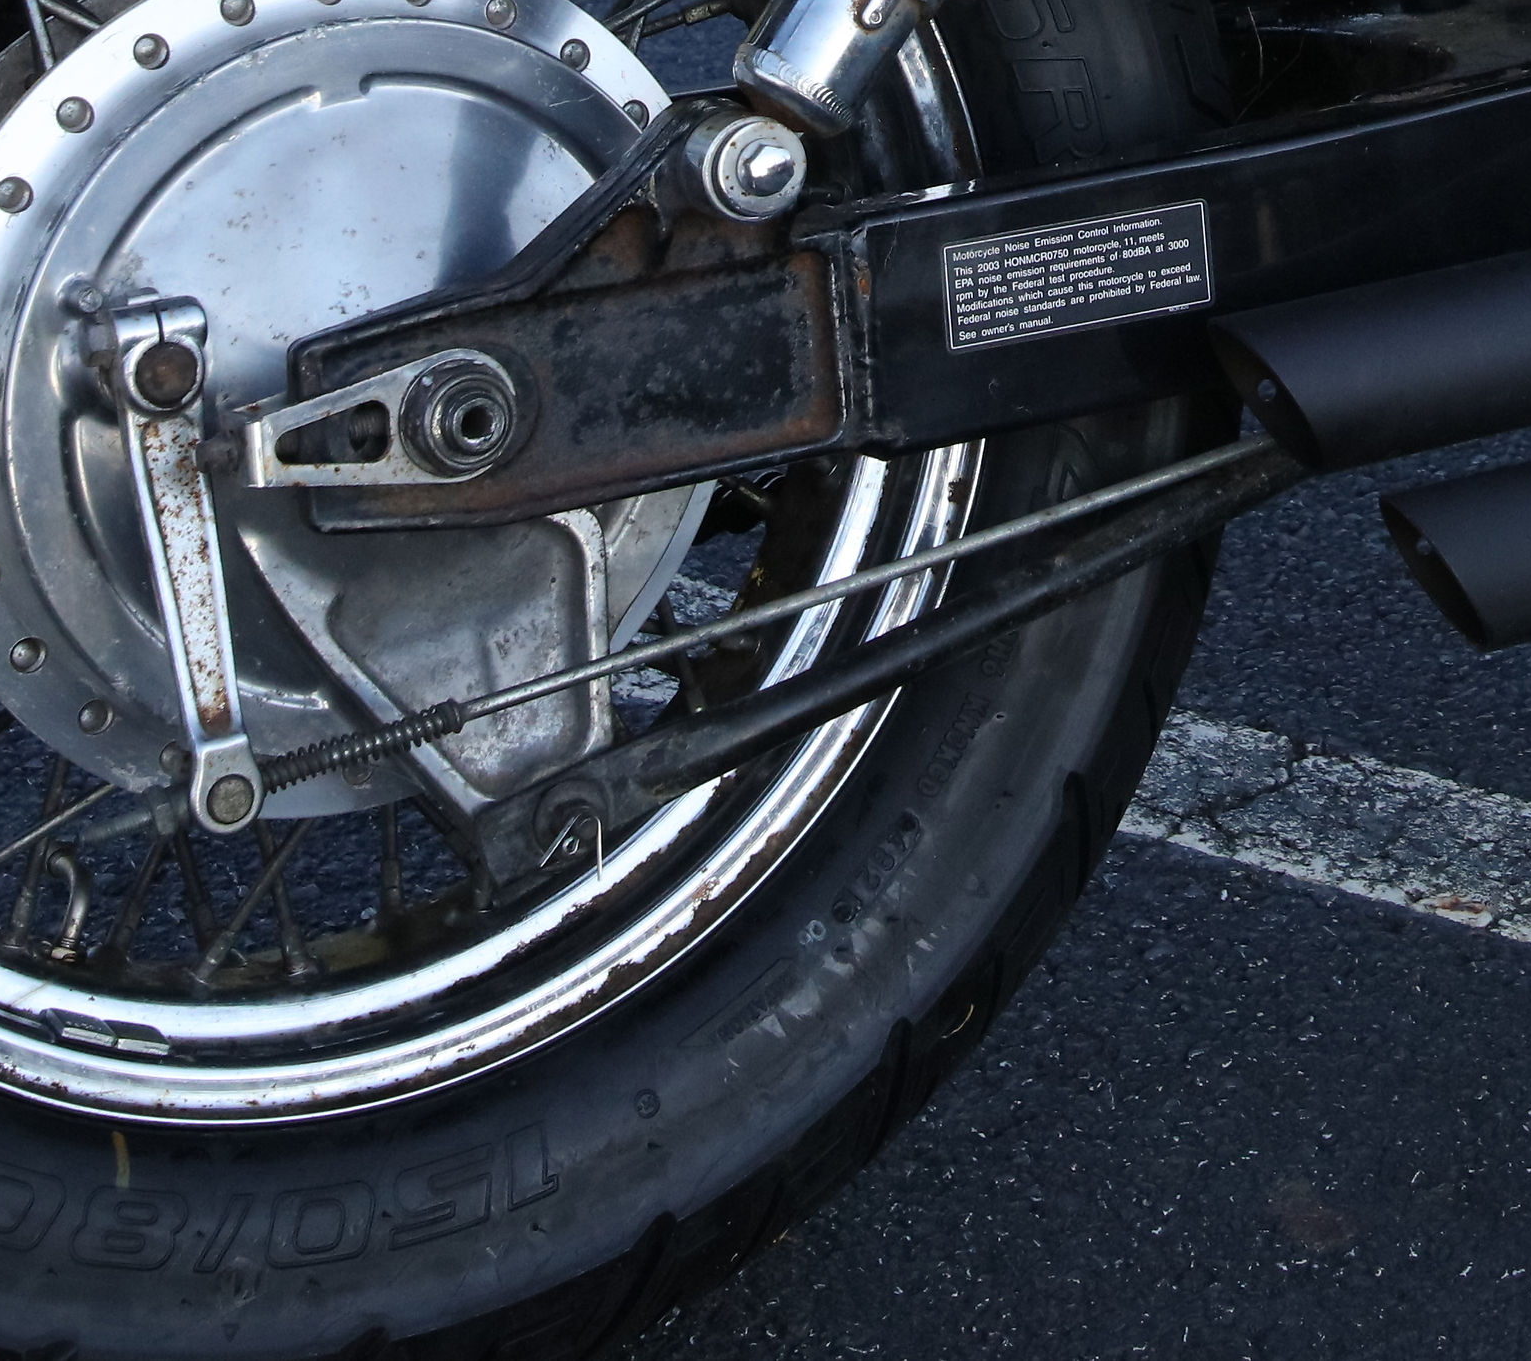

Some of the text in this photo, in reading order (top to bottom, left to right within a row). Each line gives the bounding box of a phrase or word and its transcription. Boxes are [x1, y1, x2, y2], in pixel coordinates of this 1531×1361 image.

[952, 218, 1163, 263] Motorcycle Noise Emission Control Information.
[953, 265, 974, 278] This
[977, 260, 1001, 274] 2003
[1004, 248, 1070, 269] HONMCR0750
[1073, 239, 1123, 256] motorcycle,
[1138, 232, 1166, 245] meets
[954, 238, 1190, 290] EPA noise emission requirements of 80dBA at 3000
[955, 266, 1116, 304] rpm by the Federal test procedure.
[956, 262, 1192, 314] Modifications which cause this motorcycle to exceed
[957, 274, 1203, 326] Federal noise standards are prohibited by Federal law.
[958, 315, 1054, 342] See owner's manual.
